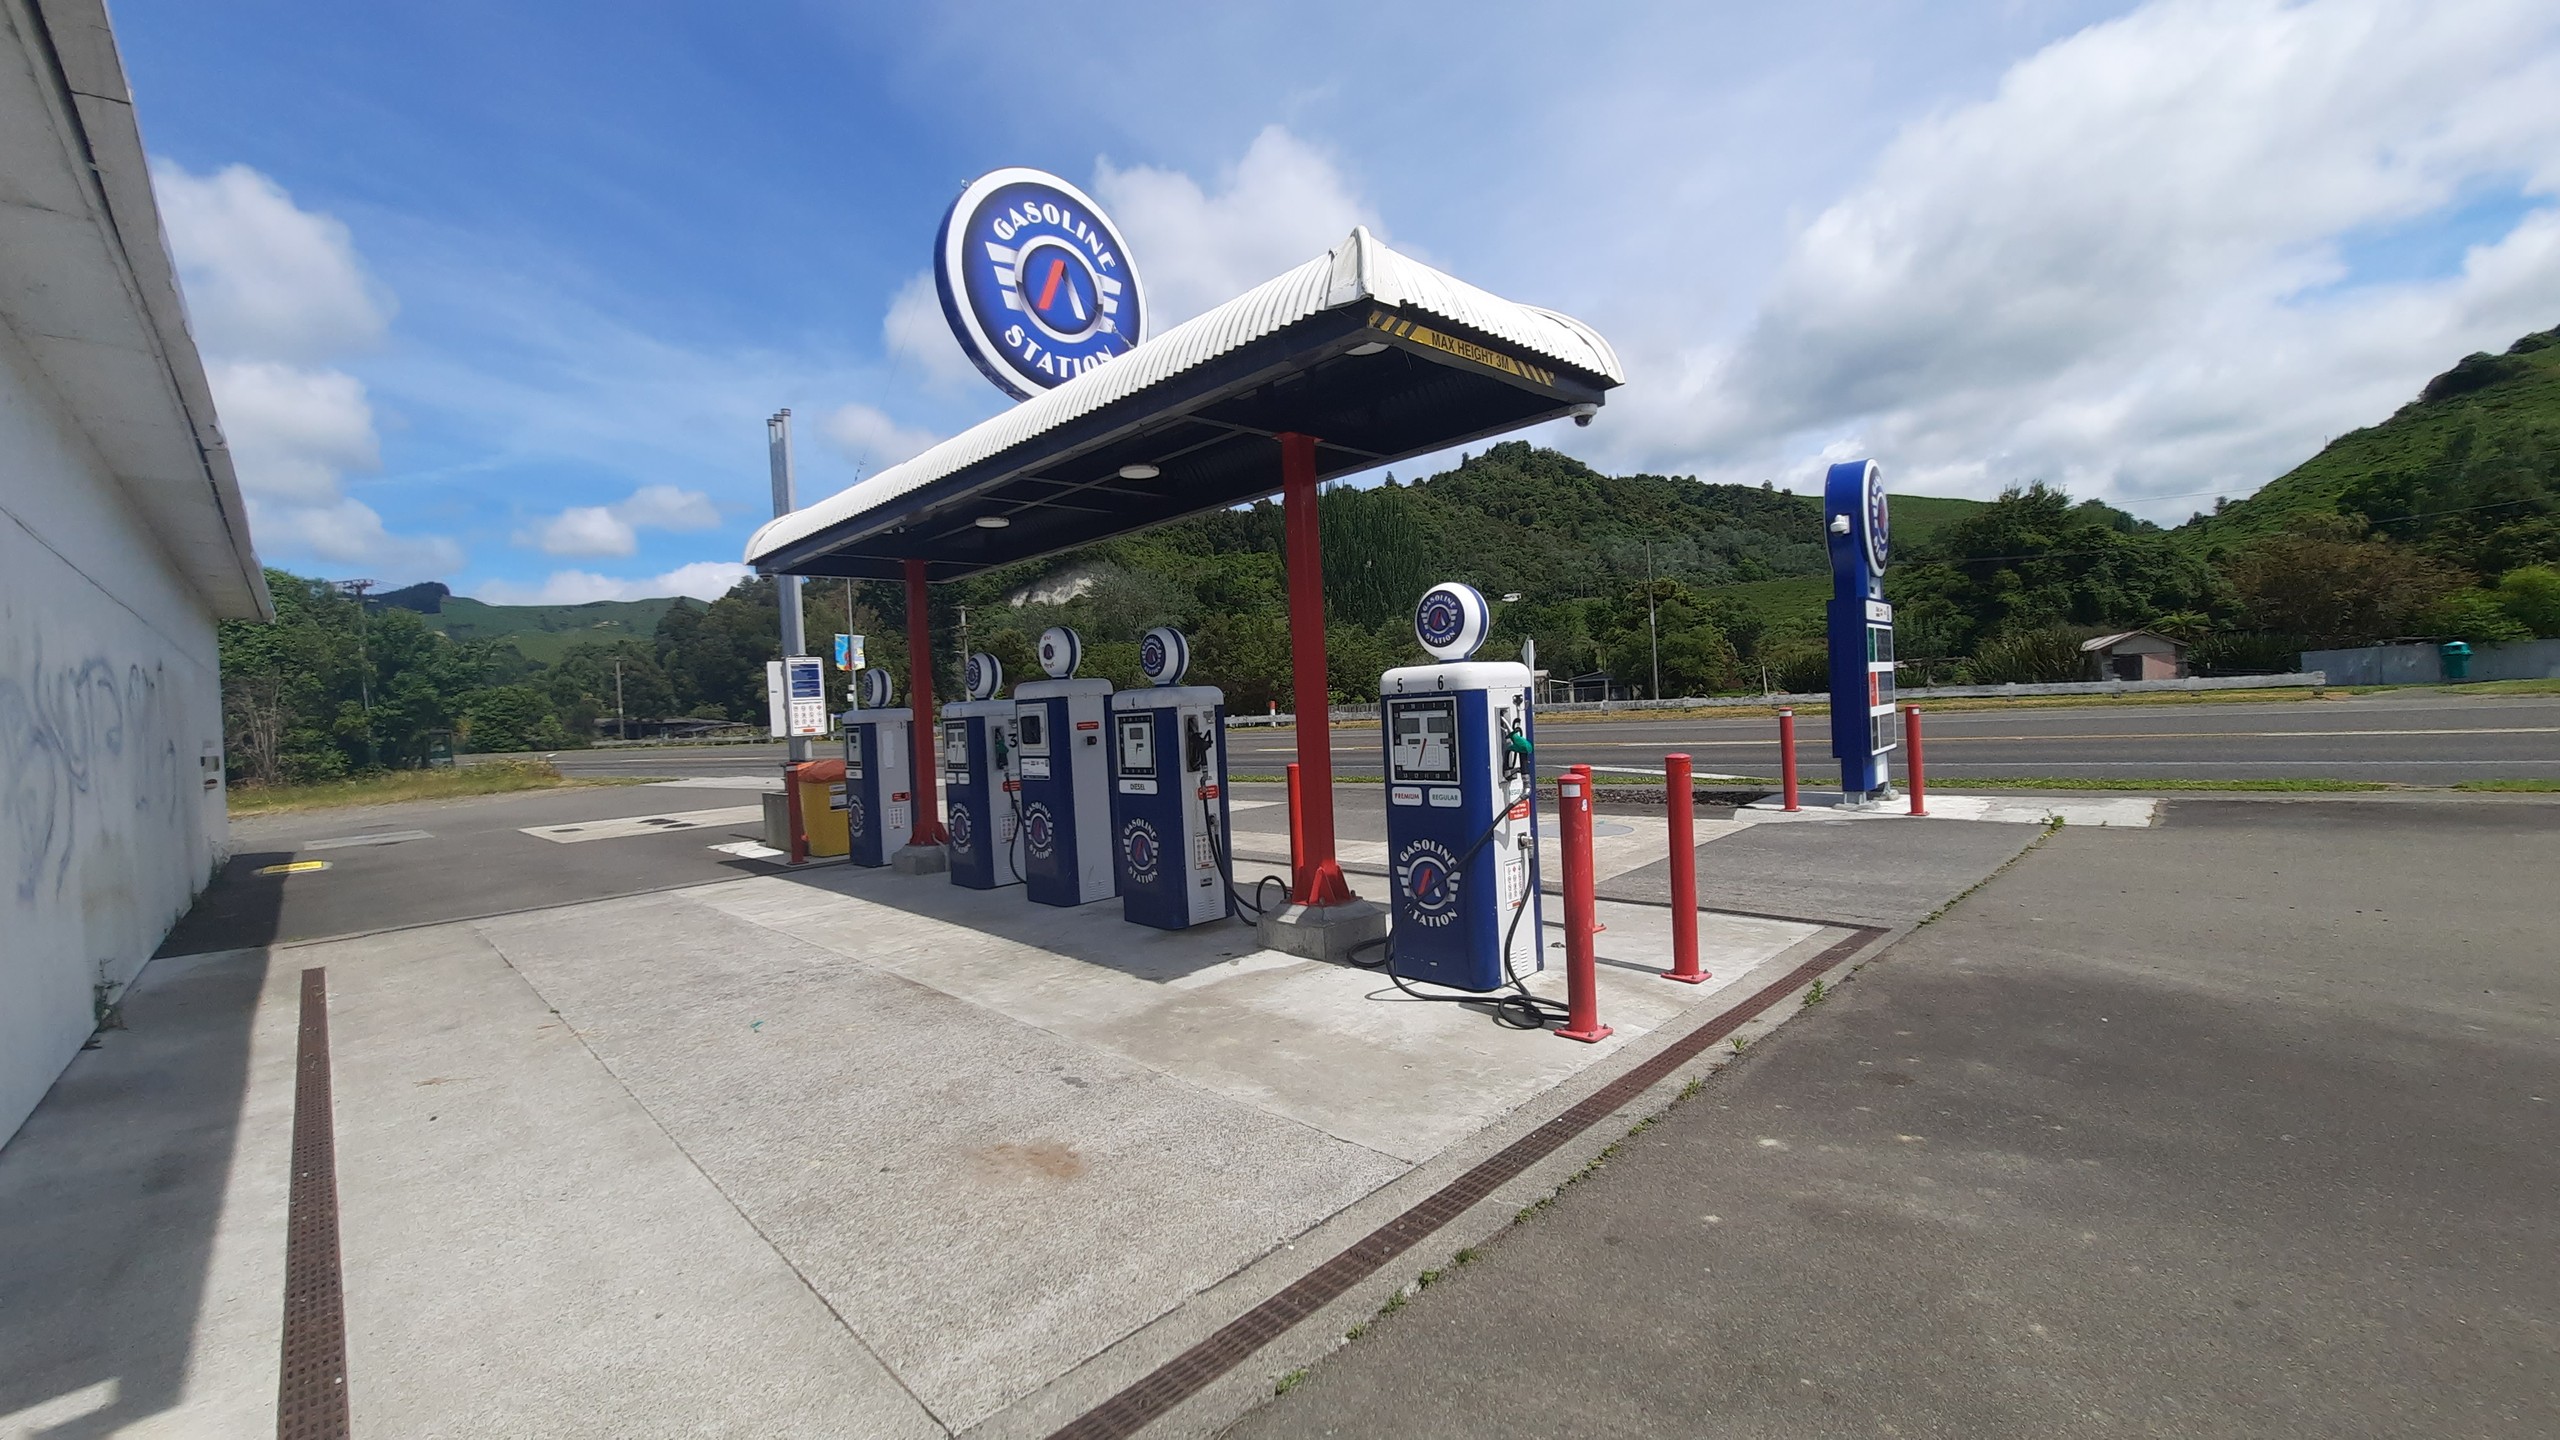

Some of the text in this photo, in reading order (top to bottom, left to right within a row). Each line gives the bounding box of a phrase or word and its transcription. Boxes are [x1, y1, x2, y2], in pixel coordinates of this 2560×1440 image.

[993, 201, 1116, 271] GASOLINE
[1004, 324, 1116, 378] STATION
[1431, 332, 1511, 371] MAX HEIGHT 3M
[1422, 594, 1457, 611] GASOLINE
[1425, 630, 1456, 644] STATION
[1397, 674, 1444, 693] 5 6
[1007, 733, 1018, 748] 3
[1394, 792, 1458, 801] PREMIUM REGULAR
[1124, 818, 1157, 839] GASOLINE
[1399, 839, 1458, 869] GASOLINE
[1127, 866, 1158, 884] STATION
[1404, 902, 1458, 928] TATION
